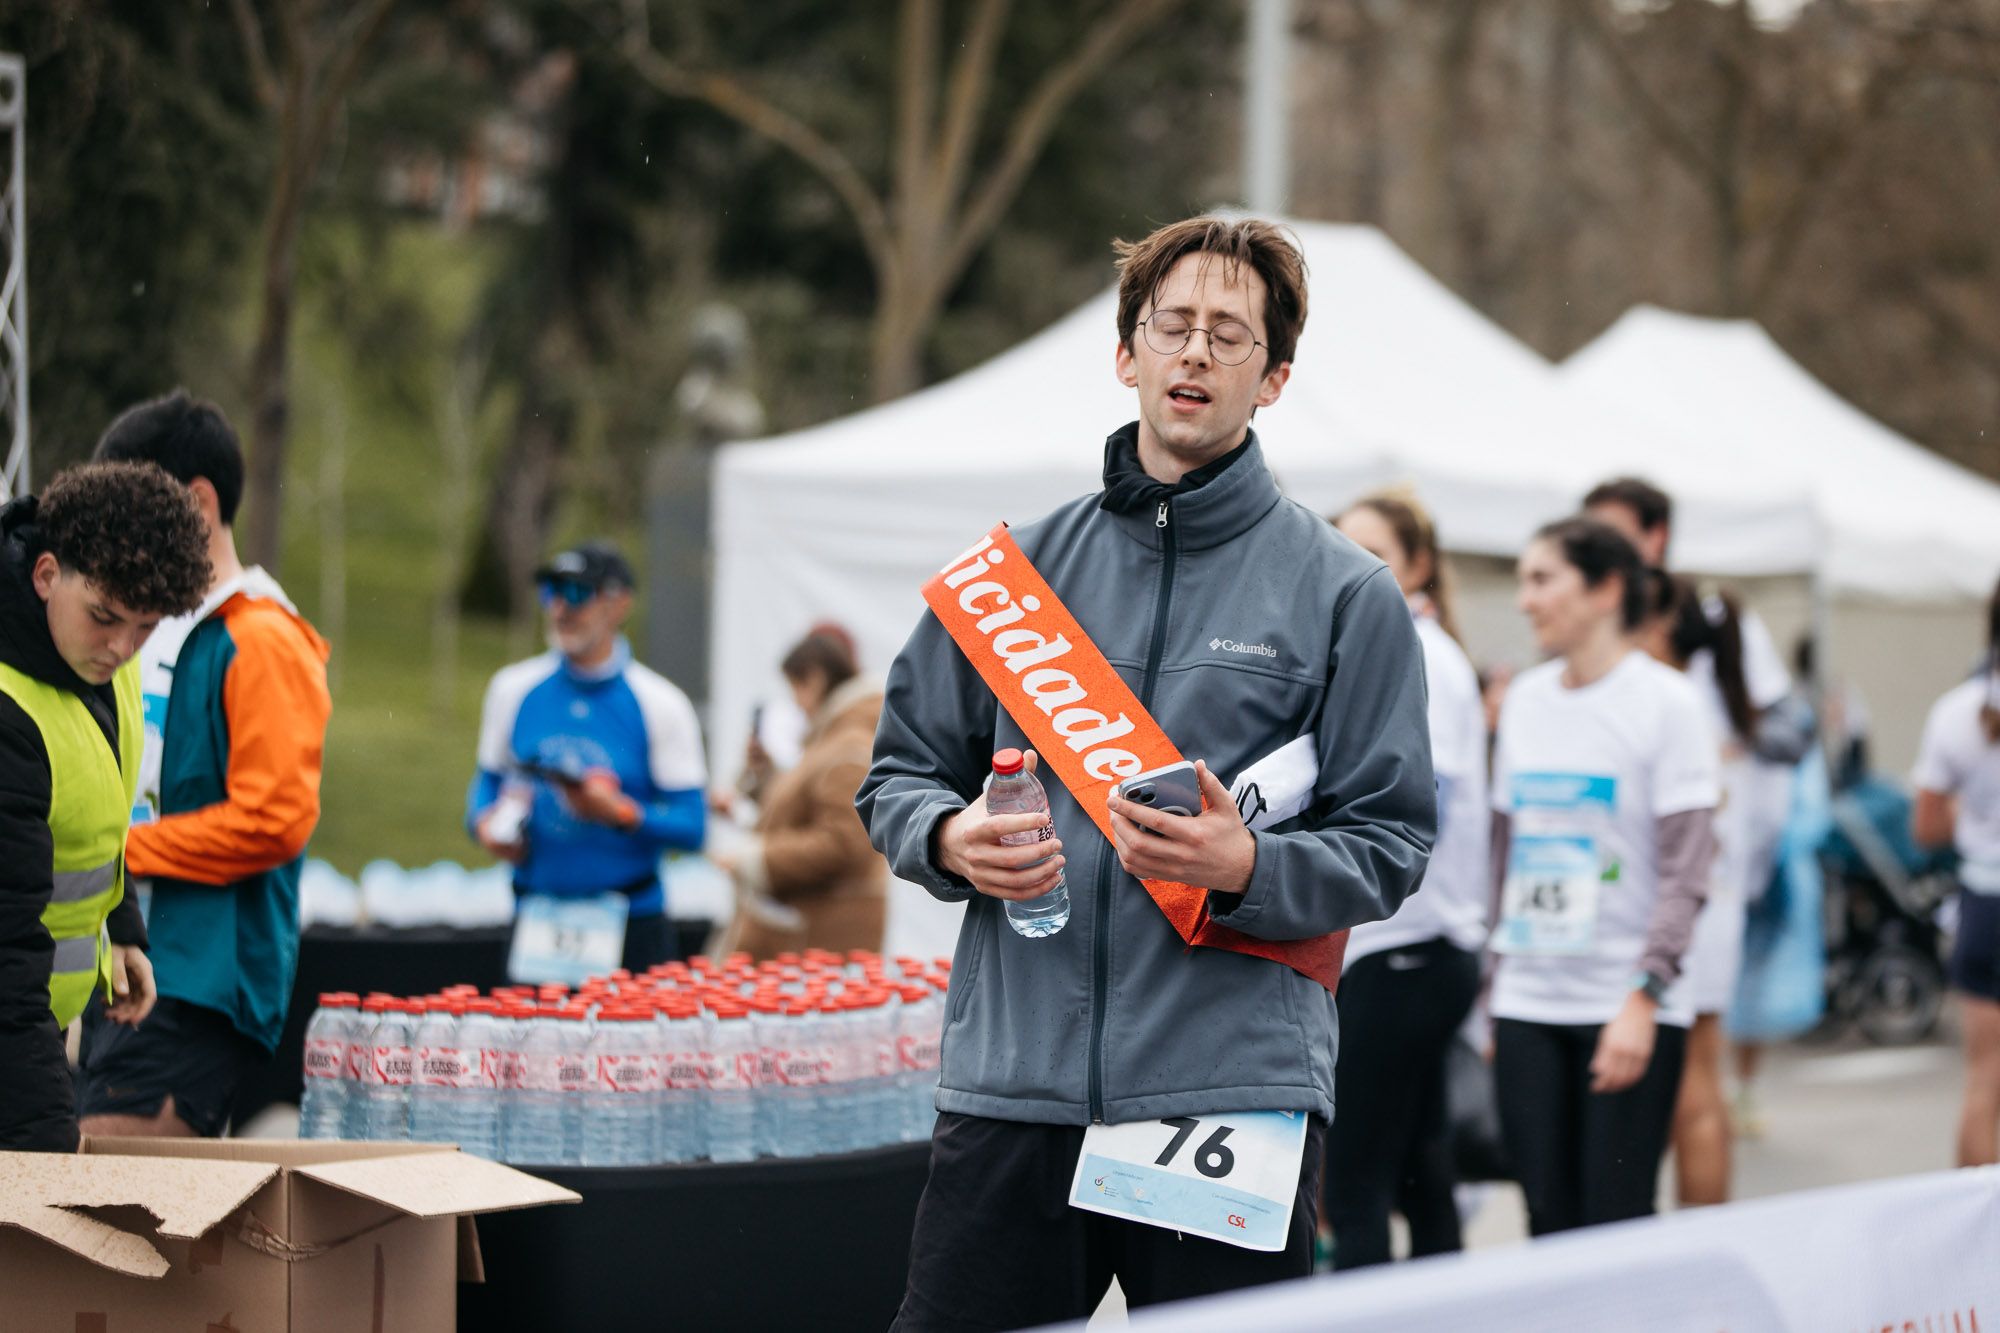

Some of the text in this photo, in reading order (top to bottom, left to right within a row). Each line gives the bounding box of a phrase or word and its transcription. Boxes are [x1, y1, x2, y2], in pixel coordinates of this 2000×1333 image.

[1222, 639, 1277, 658] Columbia
[1154, 1115, 1236, 1179] 76
[1227, 1213, 1247, 1229] CSL
